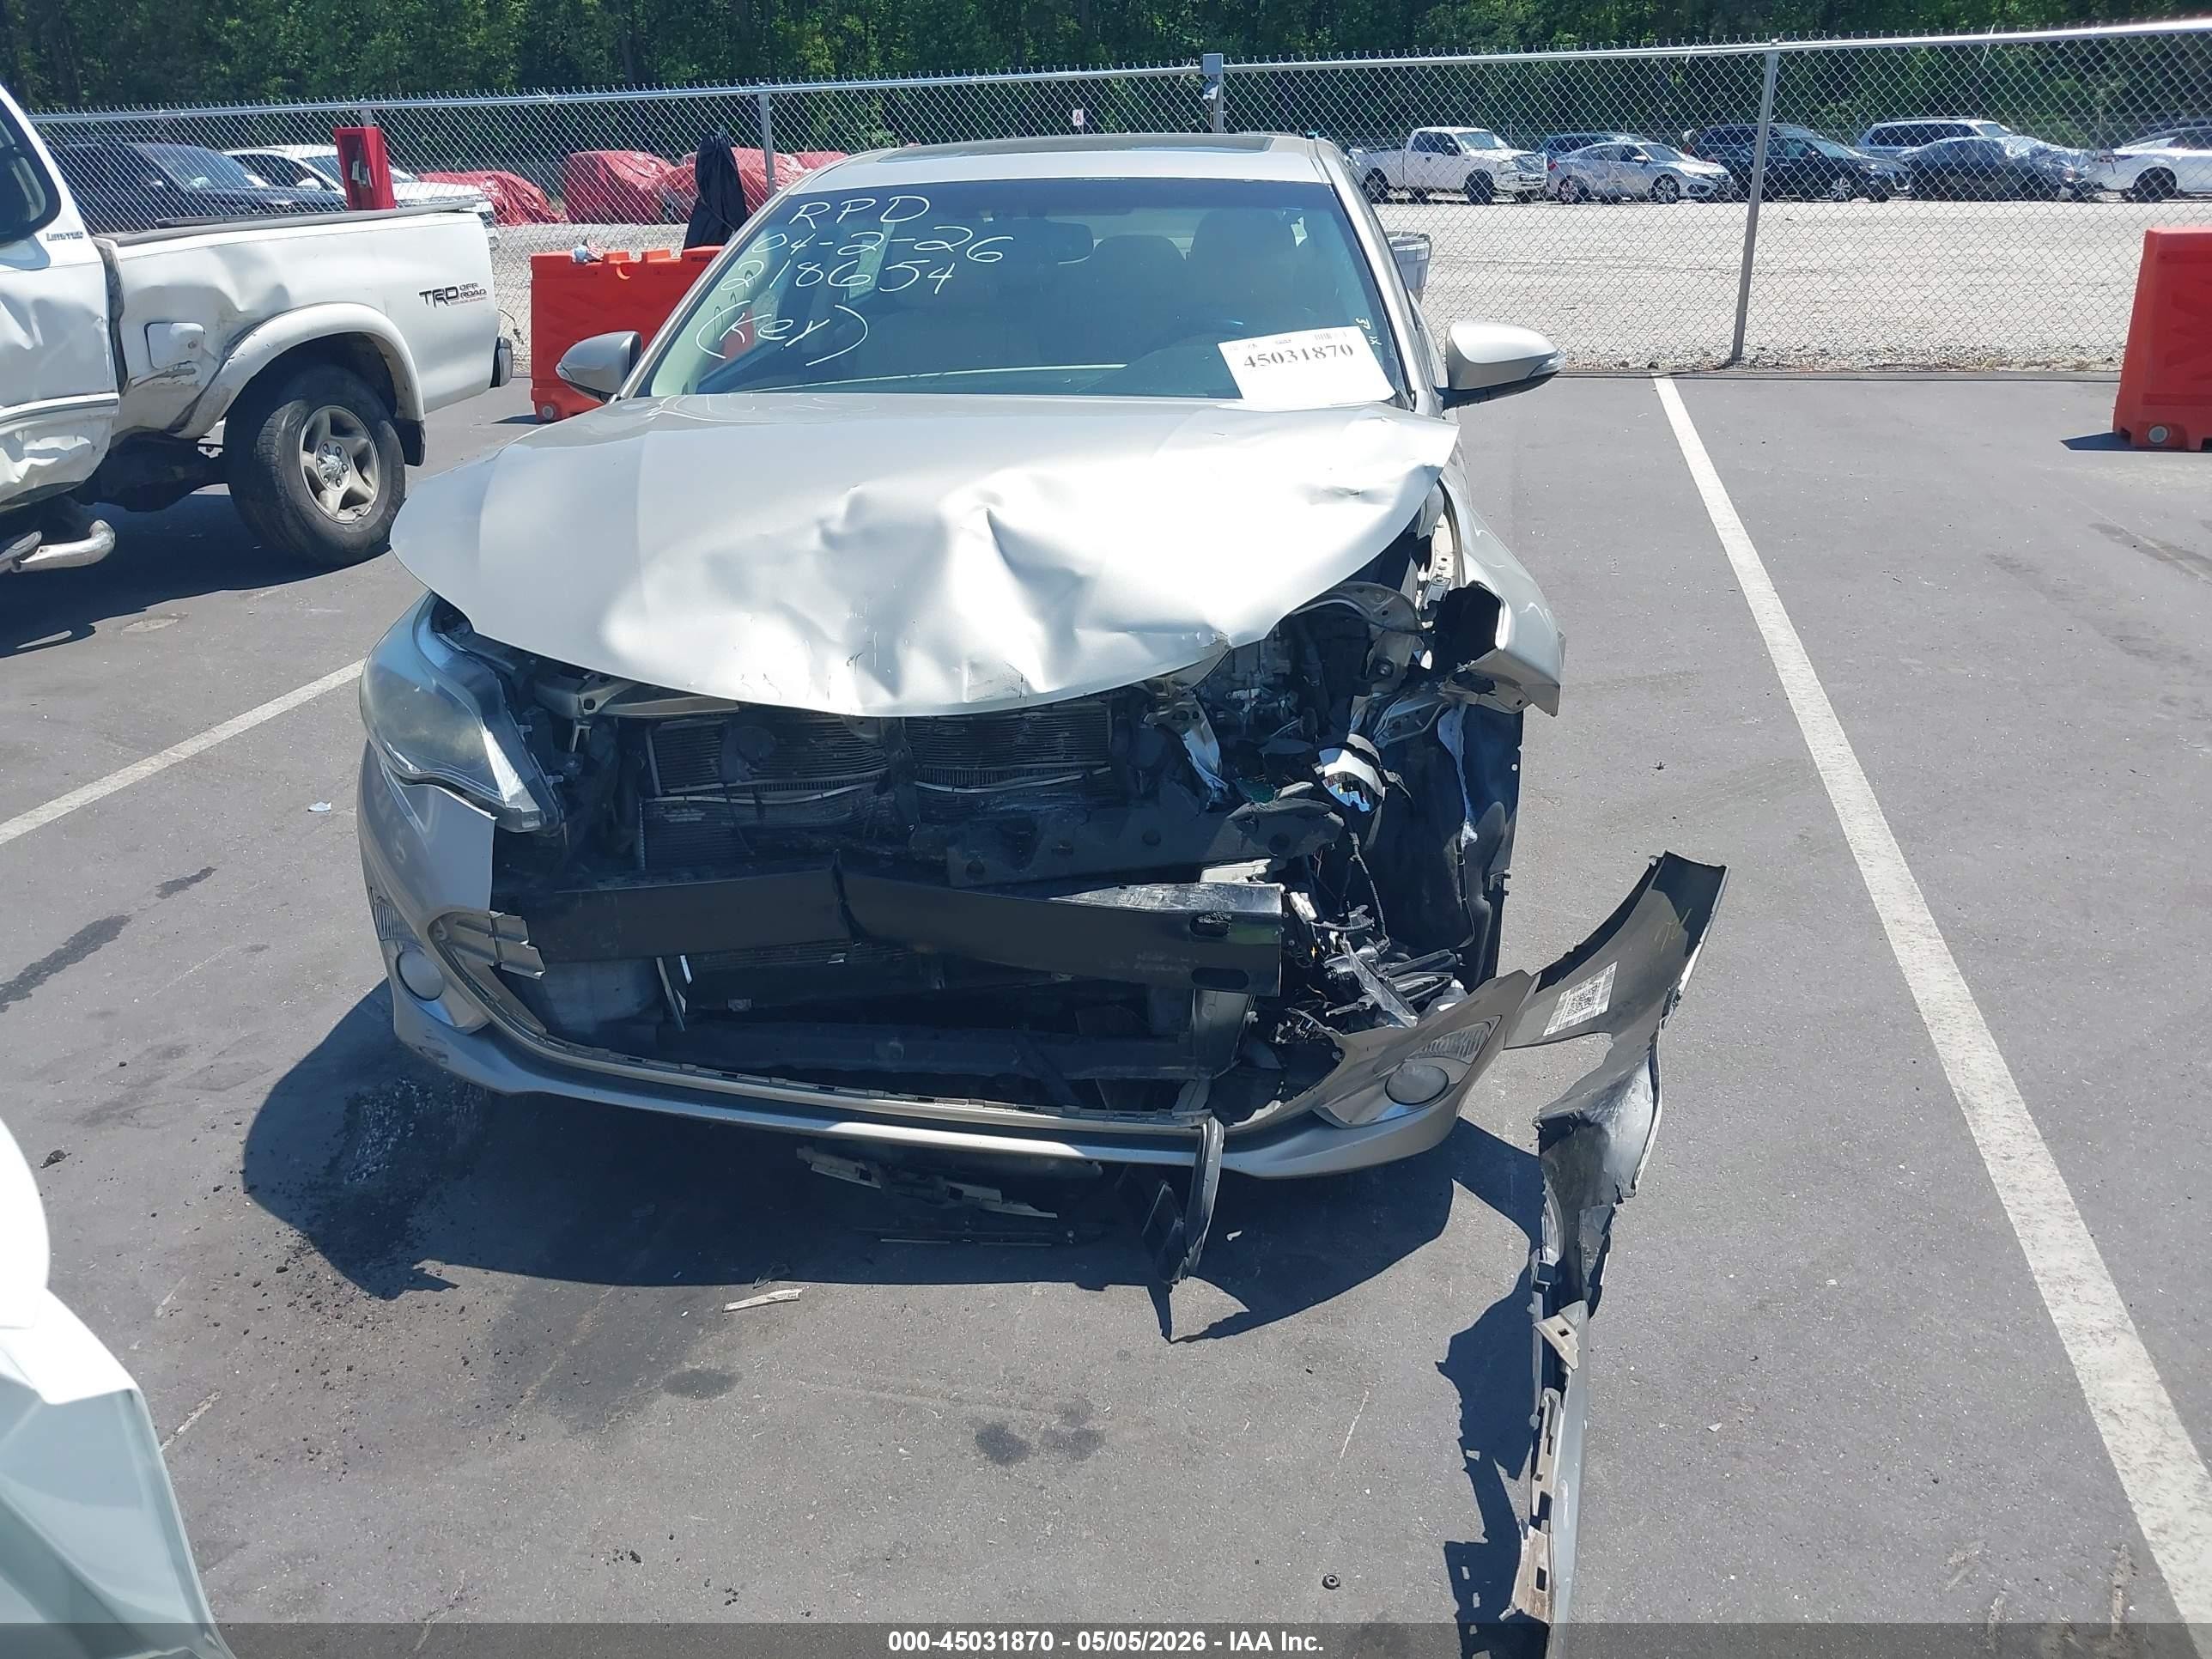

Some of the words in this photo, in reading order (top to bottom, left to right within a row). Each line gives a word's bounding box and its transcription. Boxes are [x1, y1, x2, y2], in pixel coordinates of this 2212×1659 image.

[788, 195, 931, 229] RPD
[751, 226, 1014, 263] 04-2-26
[720, 258, 956, 295] 218654
[418, 286, 459, 308] TRD
[459, 288, 487, 299] ROAD
[1243, 343, 1354, 368] 45031870
